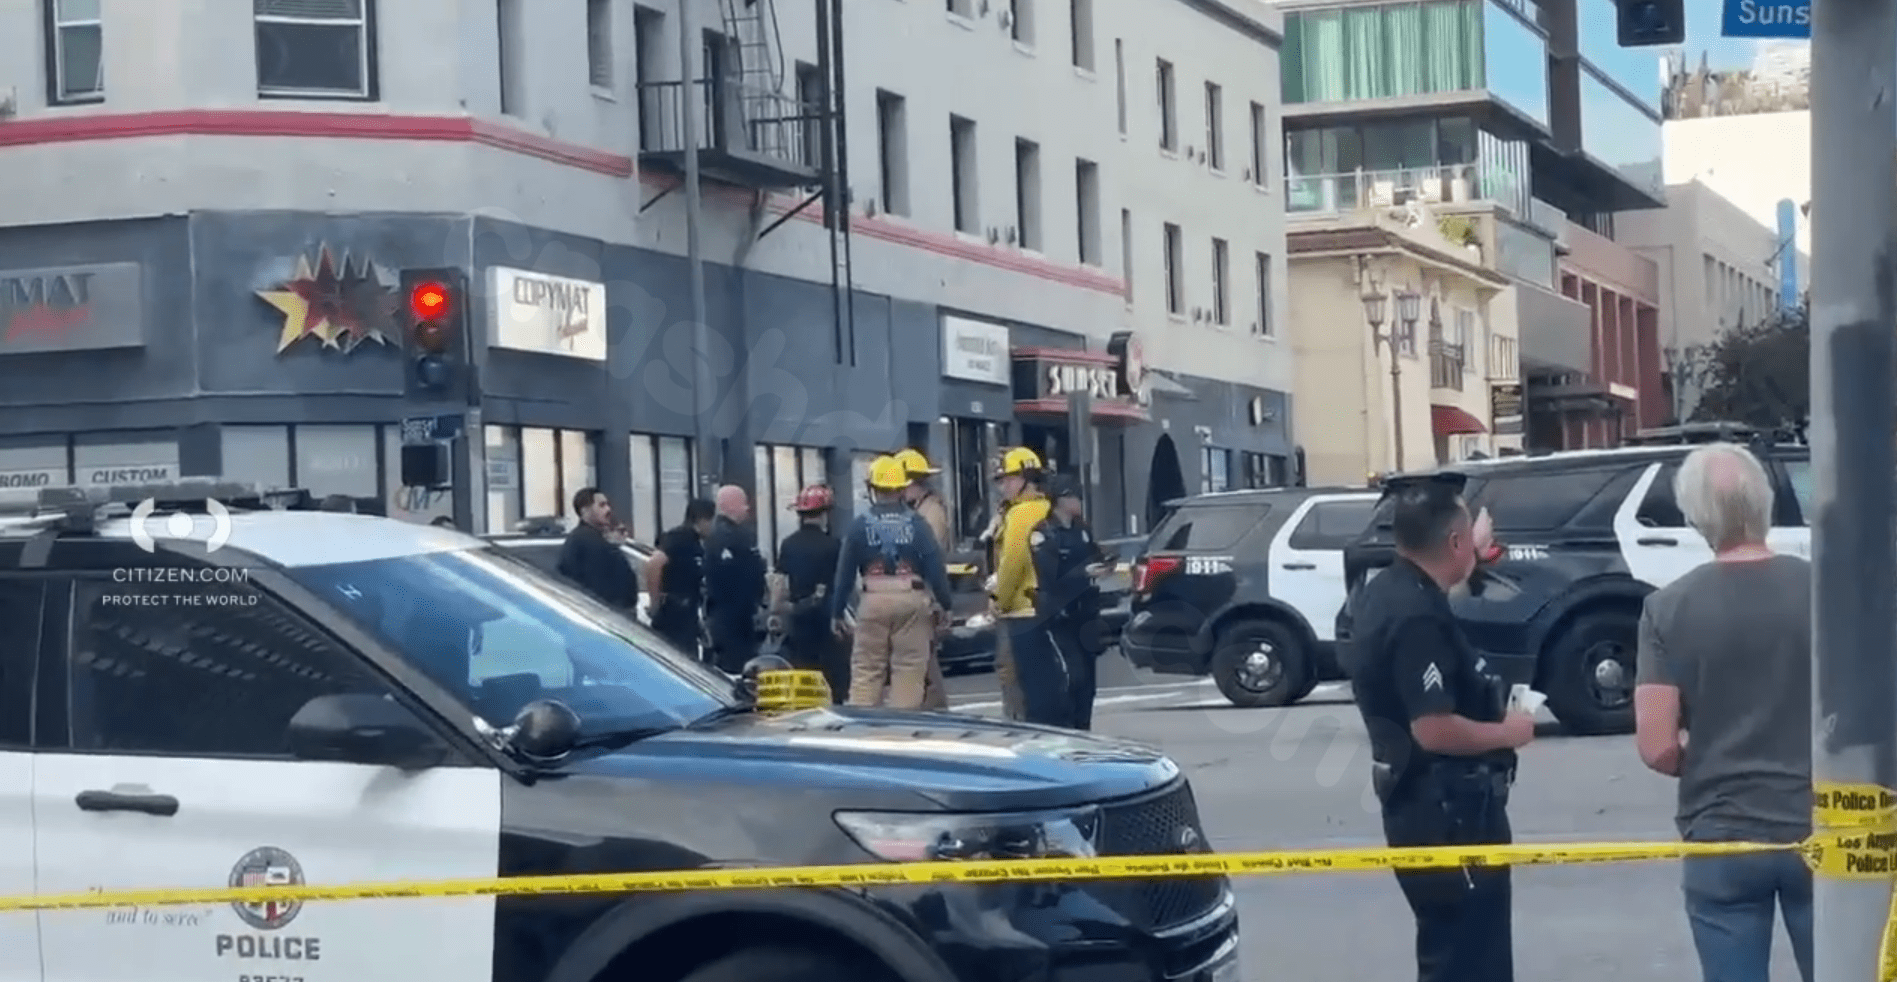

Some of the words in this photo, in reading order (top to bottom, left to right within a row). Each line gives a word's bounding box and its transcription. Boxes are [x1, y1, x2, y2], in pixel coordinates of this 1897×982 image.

[513, 275, 590, 315] COPYMAT
[91, 468, 168, 484] CUSTOM
[1832, 790, 1876, 811] Police
[1846, 852, 1888, 872] Police
[216, 934, 320, 960] POLICE
